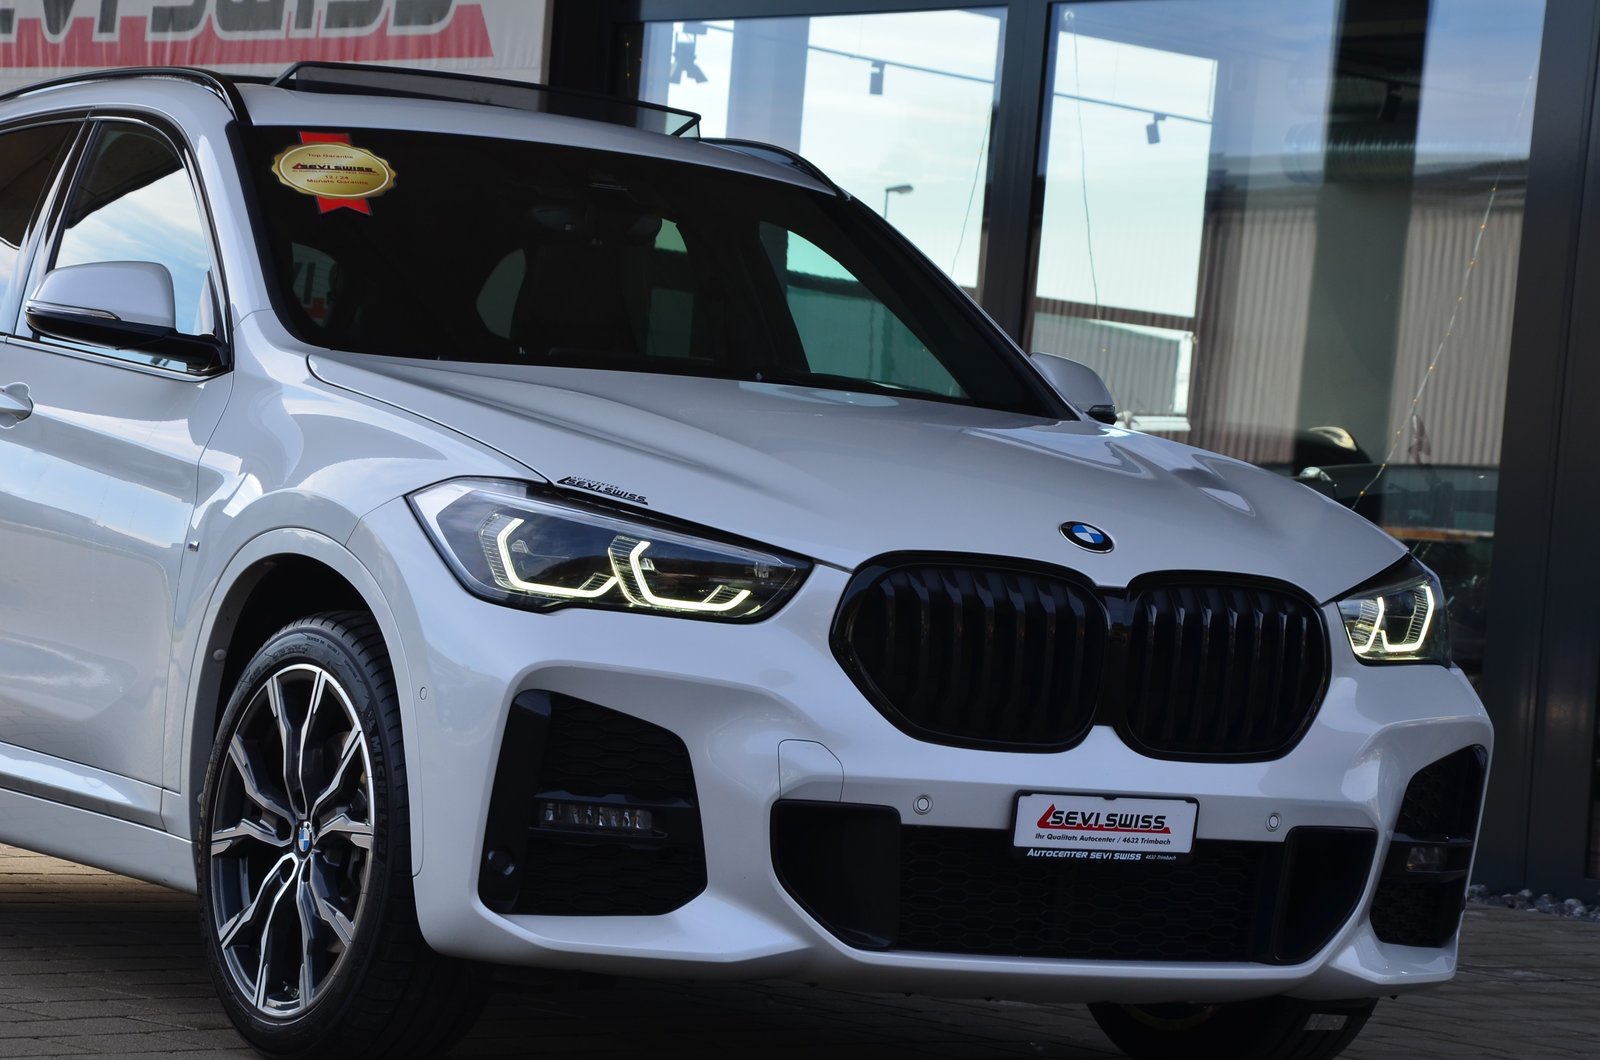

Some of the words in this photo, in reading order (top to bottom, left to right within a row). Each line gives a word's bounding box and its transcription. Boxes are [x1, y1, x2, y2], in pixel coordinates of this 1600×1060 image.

[566, 478, 602, 492] SEVI
[604, 487, 647, 503] SWISS
[1051, 810, 1101, 826] SEVI
[1105, 813, 1166, 829] SWISS
[1035, 832, 1046, 840] Ihr
[1079, 834, 1116, 842] Autocenter
[1089, 852, 1113, 860] SEVI
[1113, 852, 1141, 860] SWISS
